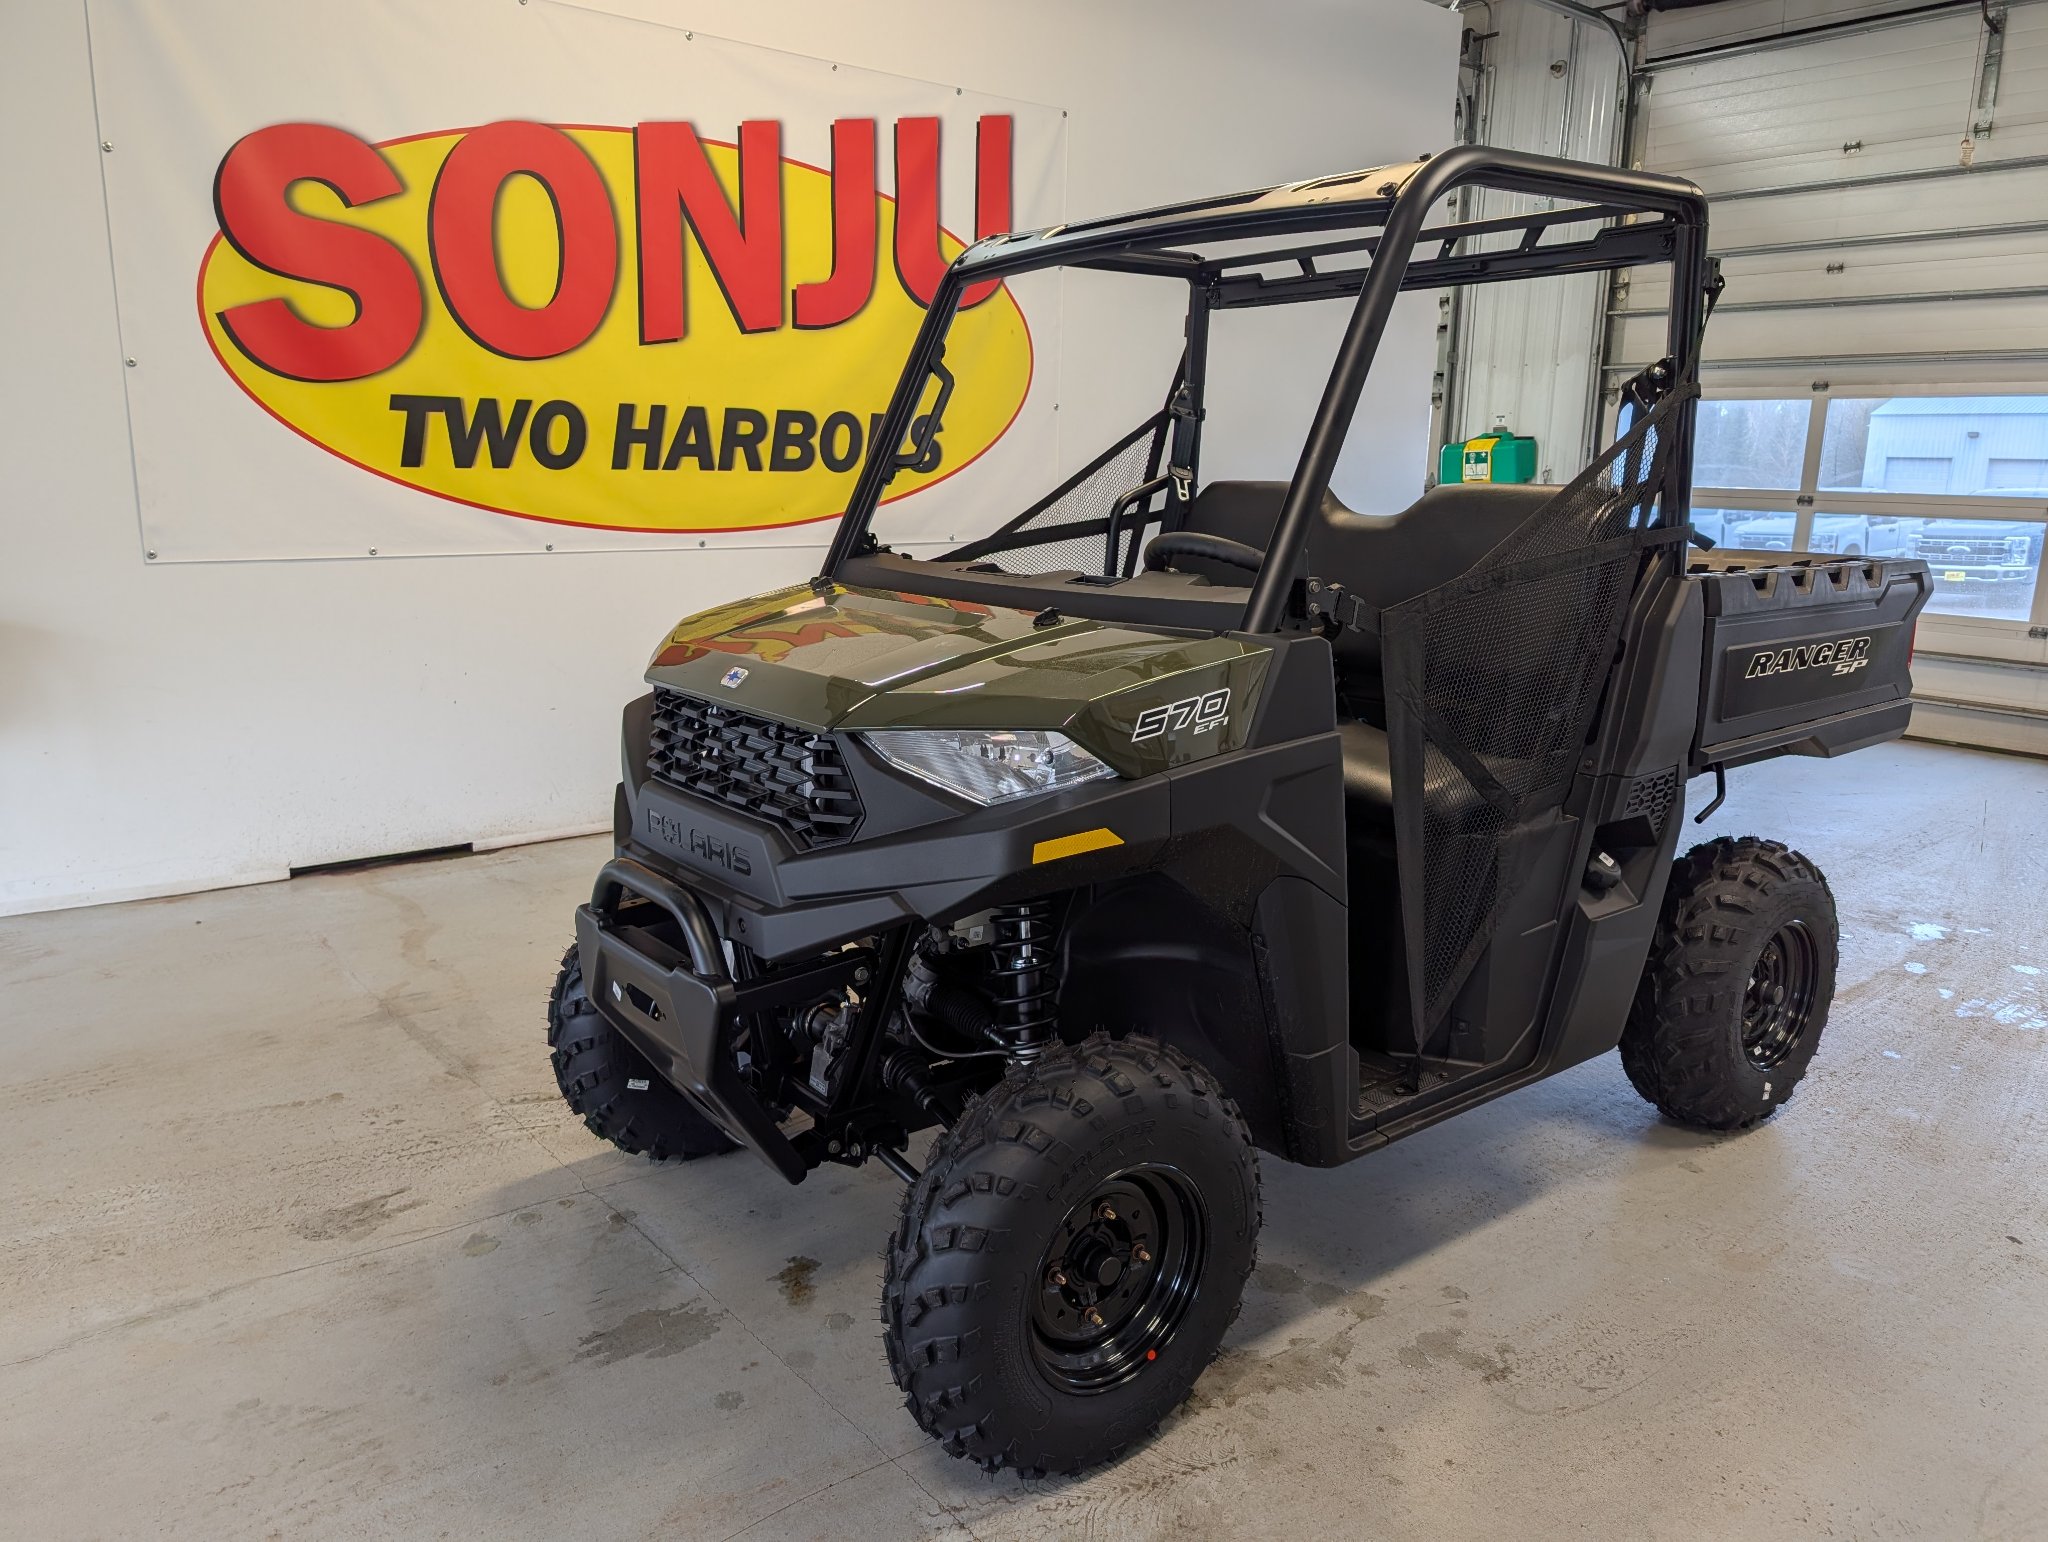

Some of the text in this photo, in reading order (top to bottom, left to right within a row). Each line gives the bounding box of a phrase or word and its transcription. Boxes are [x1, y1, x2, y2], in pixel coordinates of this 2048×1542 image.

[213, 115, 1012, 383] SONJU
[389, 394, 588, 470] TWO
[1745, 637, 1871, 679] RANGER
[1832, 659, 1869, 676] SP
[1131, 688, 1231, 742] 570
[1193, 716, 1229, 735] EFI
[647, 808, 752, 877] POLARIS
